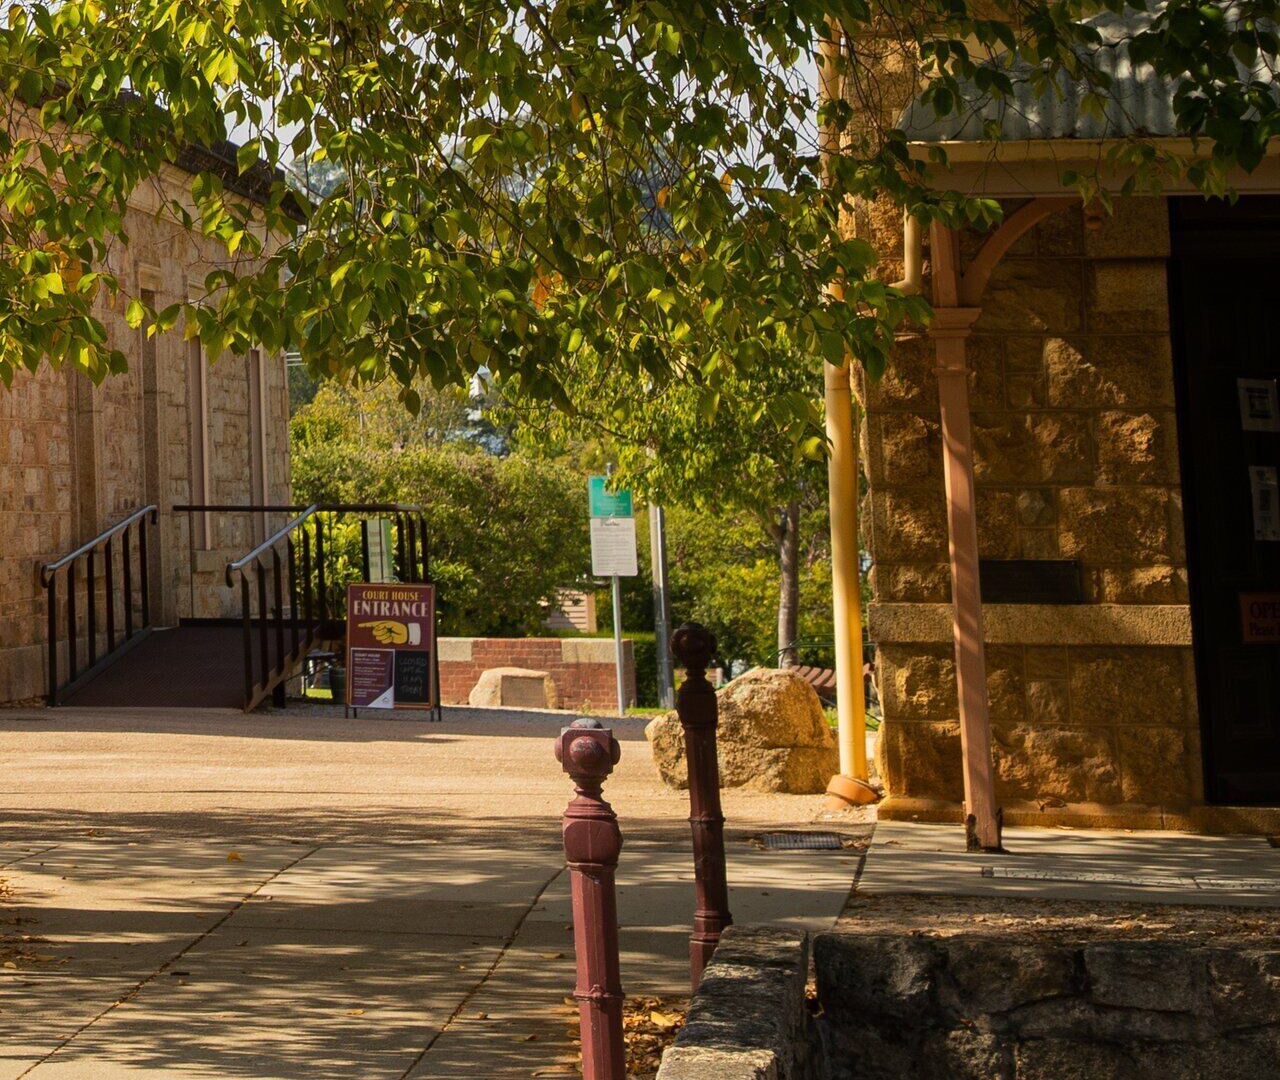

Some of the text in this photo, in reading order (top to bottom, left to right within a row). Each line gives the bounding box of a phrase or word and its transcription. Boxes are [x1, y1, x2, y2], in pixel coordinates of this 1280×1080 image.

[362, 590, 420, 601] COURT HOUSE
[353, 600, 429, 617] ENTRANCE
